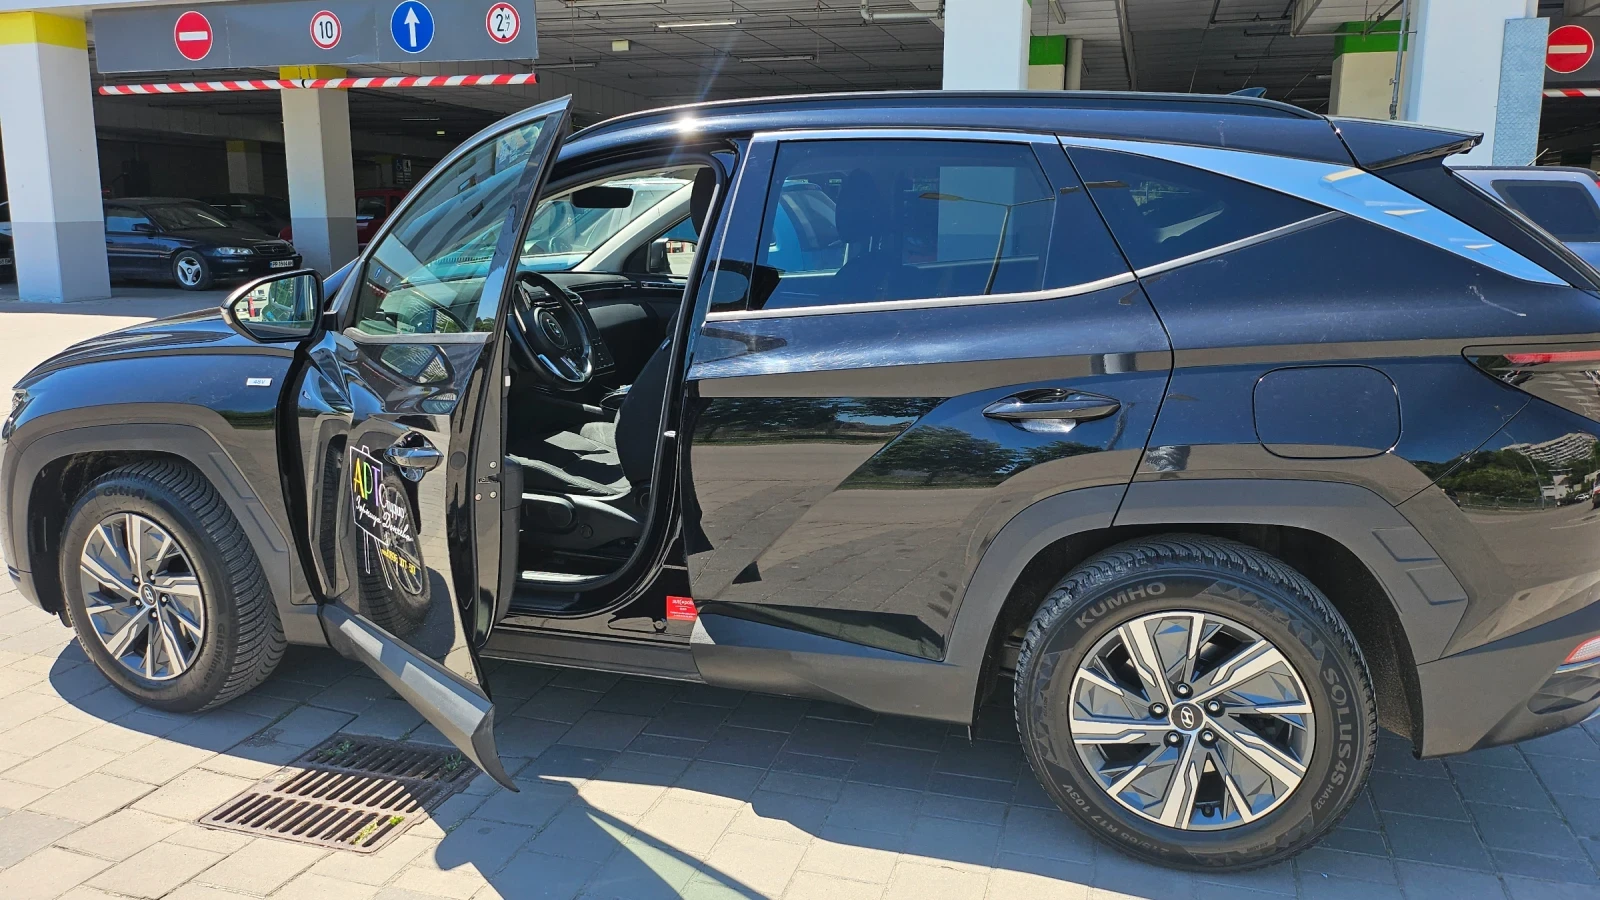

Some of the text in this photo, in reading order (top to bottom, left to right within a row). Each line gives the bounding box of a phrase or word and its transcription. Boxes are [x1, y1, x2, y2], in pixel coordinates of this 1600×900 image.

[319, 21, 334, 39] 10
[496, 13, 504, 32] 2
[1075, 581, 1167, 630] KUMHO
[1062, 783, 1092, 813] 103V
[1313, 784, 1335, 811] HA32
[1090, 815, 1119, 834] R17
